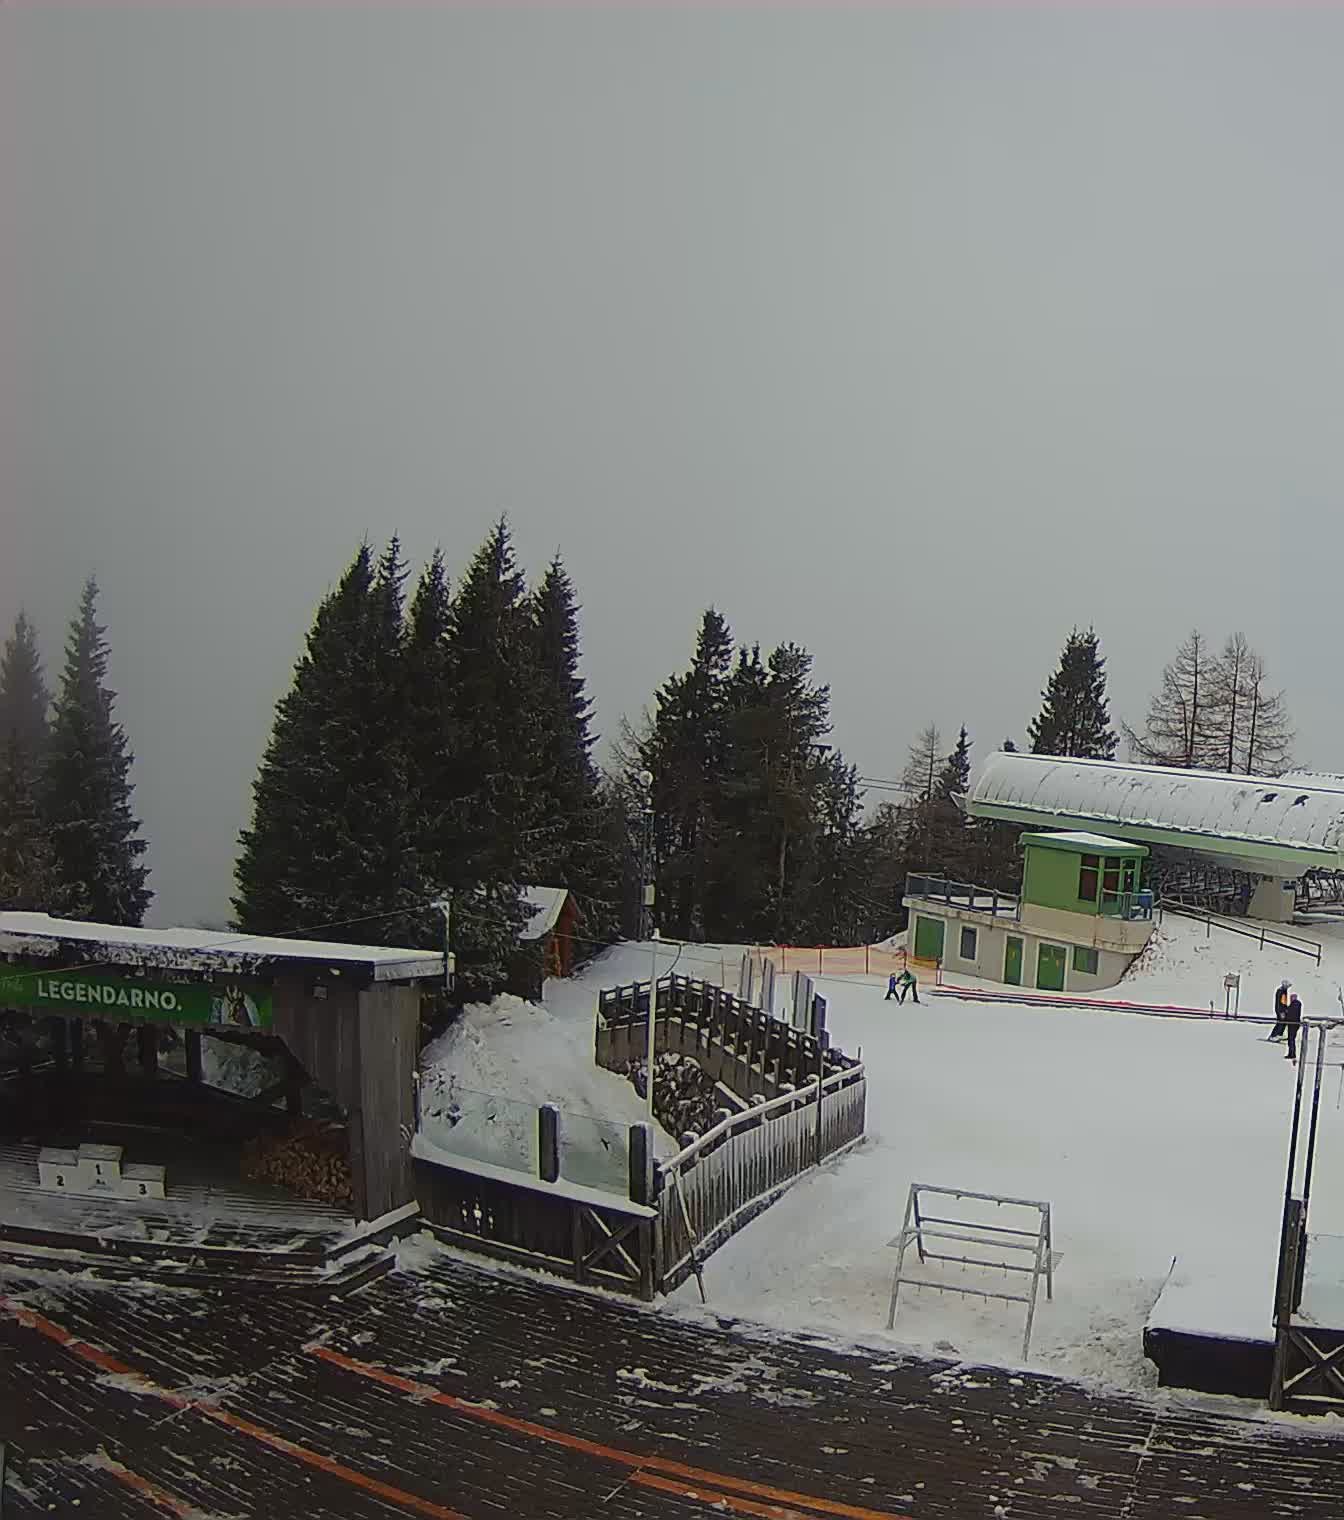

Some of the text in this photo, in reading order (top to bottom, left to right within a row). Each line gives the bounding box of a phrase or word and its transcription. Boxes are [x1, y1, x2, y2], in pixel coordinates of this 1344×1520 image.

[37, 978, 183, 1012] LEGENDARNO.
[95, 1164, 102, 1175] 1
[56, 1175, 65, 1187] 2
[138, 1183, 148, 1195] 3
